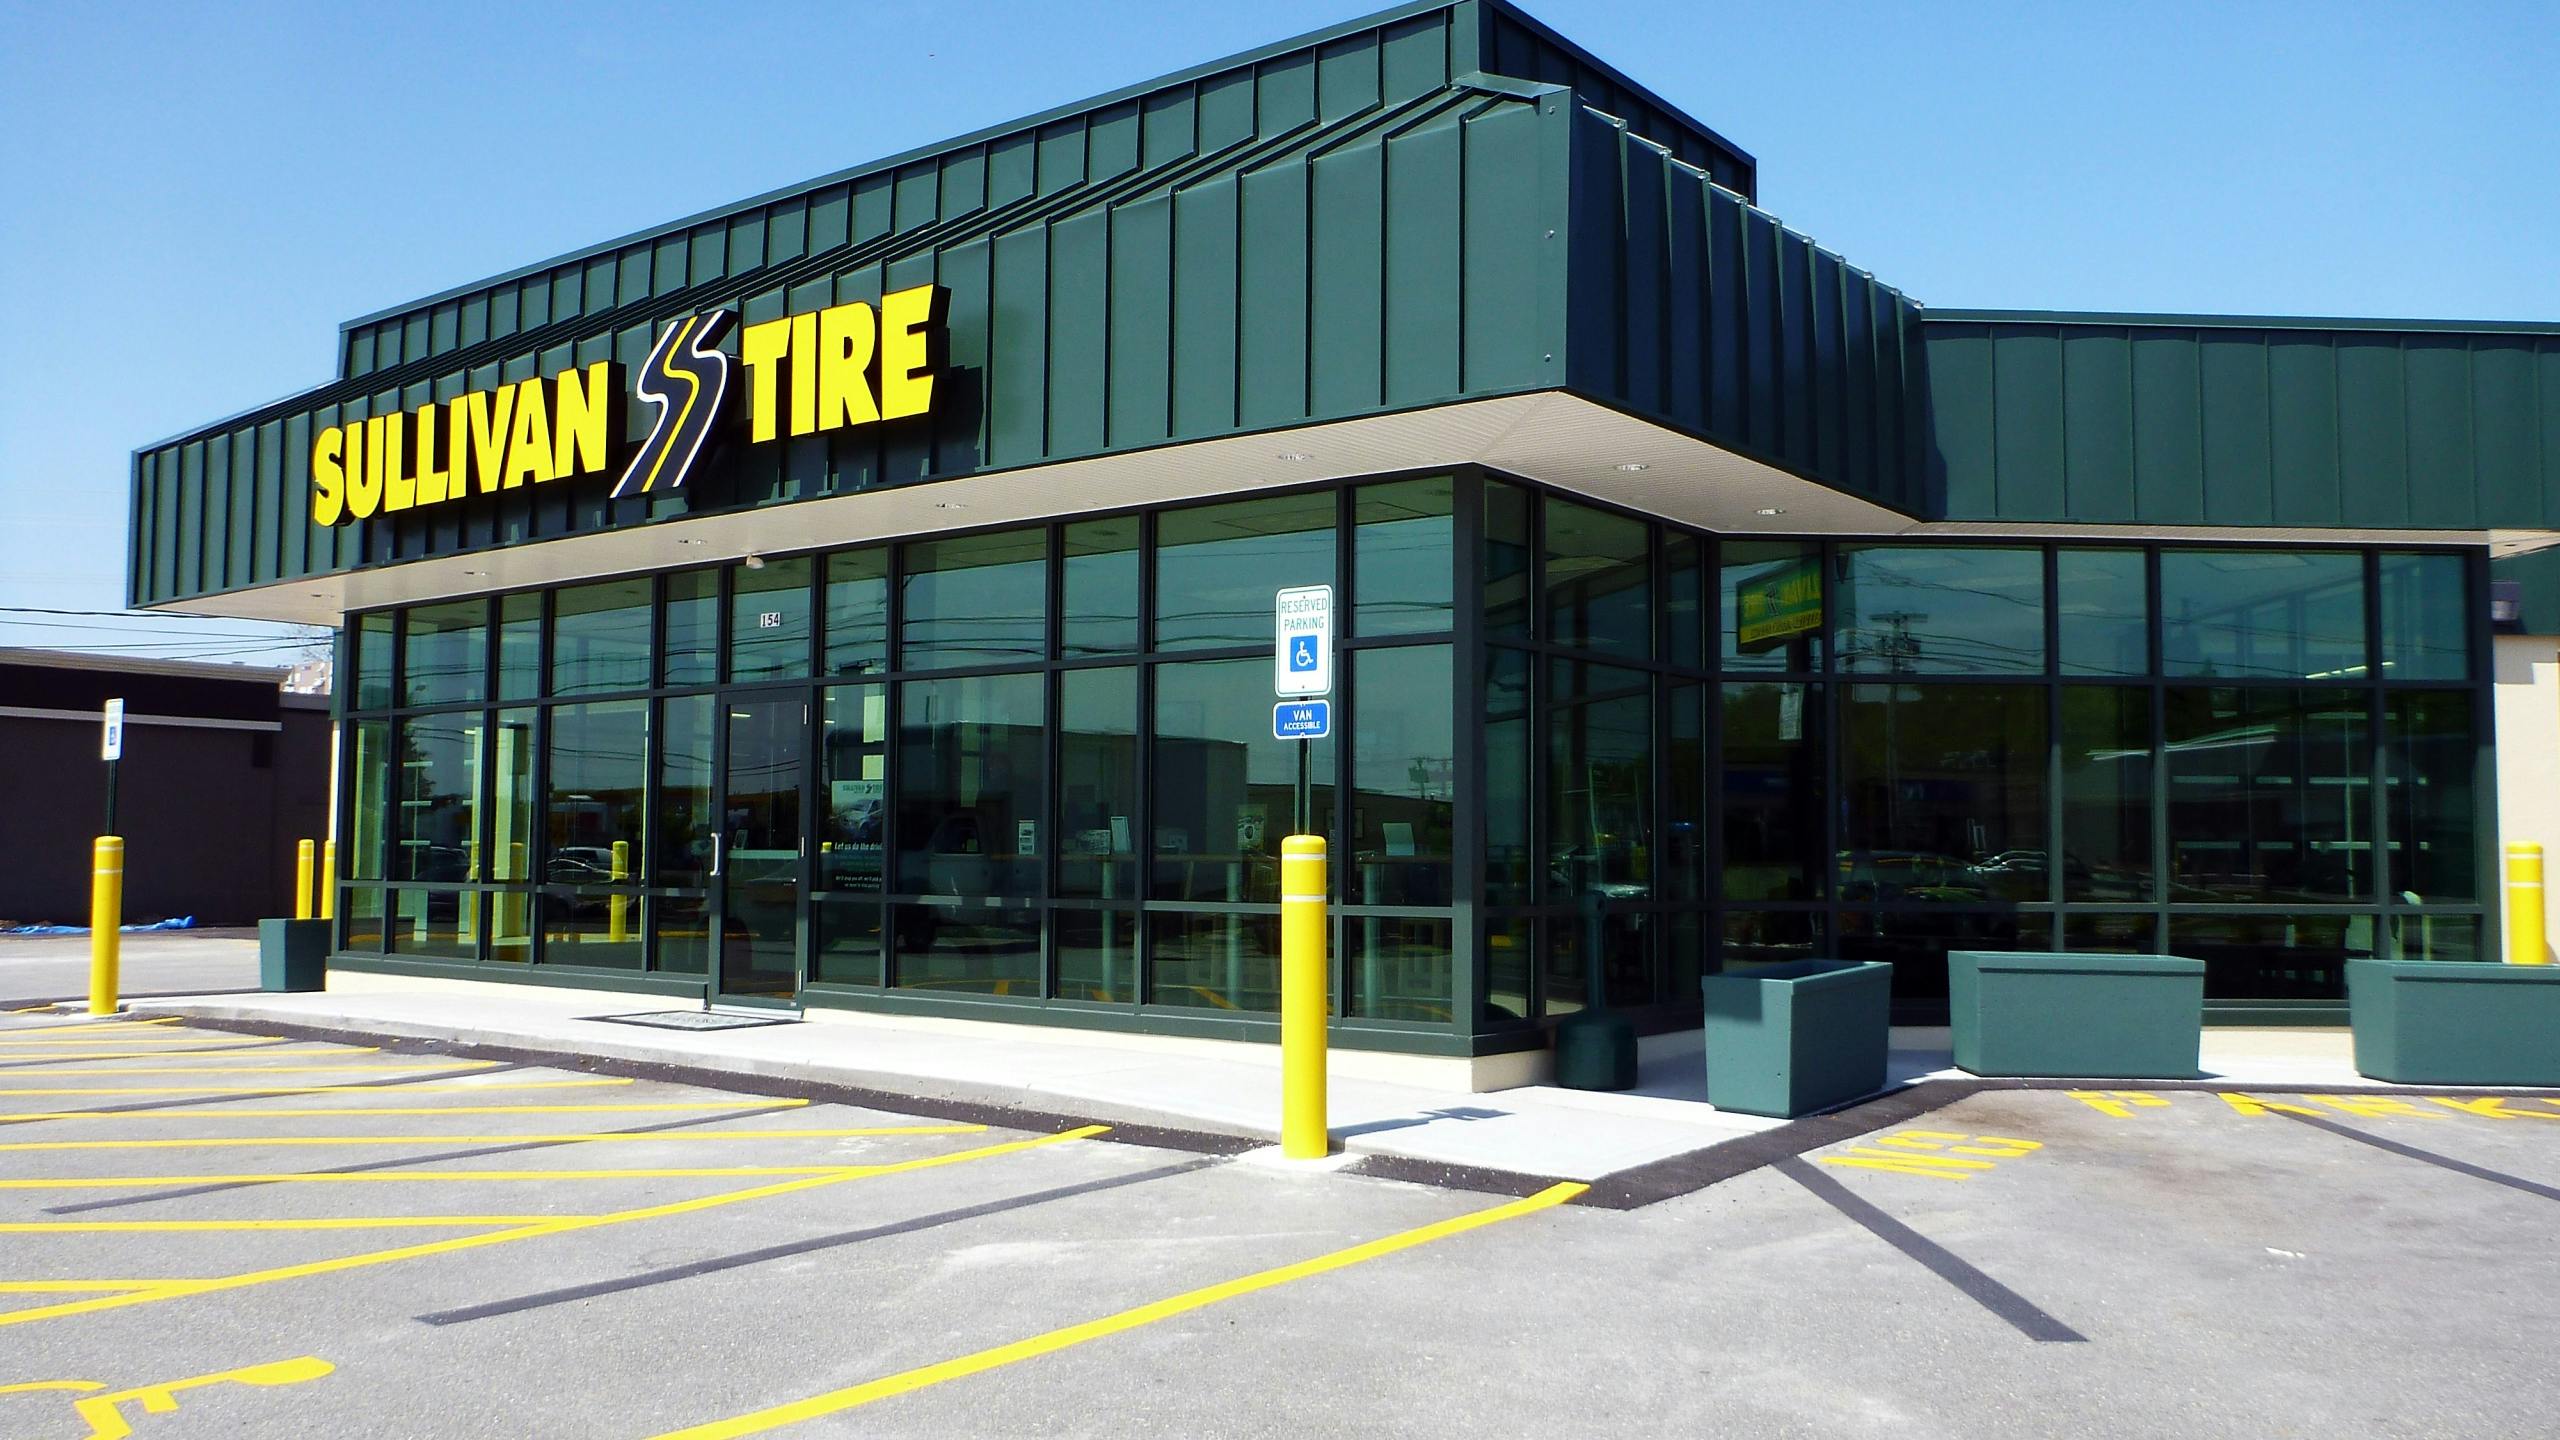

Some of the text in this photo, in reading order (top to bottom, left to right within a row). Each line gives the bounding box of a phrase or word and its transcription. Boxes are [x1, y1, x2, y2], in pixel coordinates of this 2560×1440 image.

[315, 283, 935, 527] SULLIVAN TIRE
[1280, 598, 1328, 614] RESERVED
[762, 613, 779, 627] 154
[1284, 616, 1325, 631] PARKING
[1293, 709, 1313, 721] VAN
[1283, 720, 1321, 731] ACCESSIBLE
